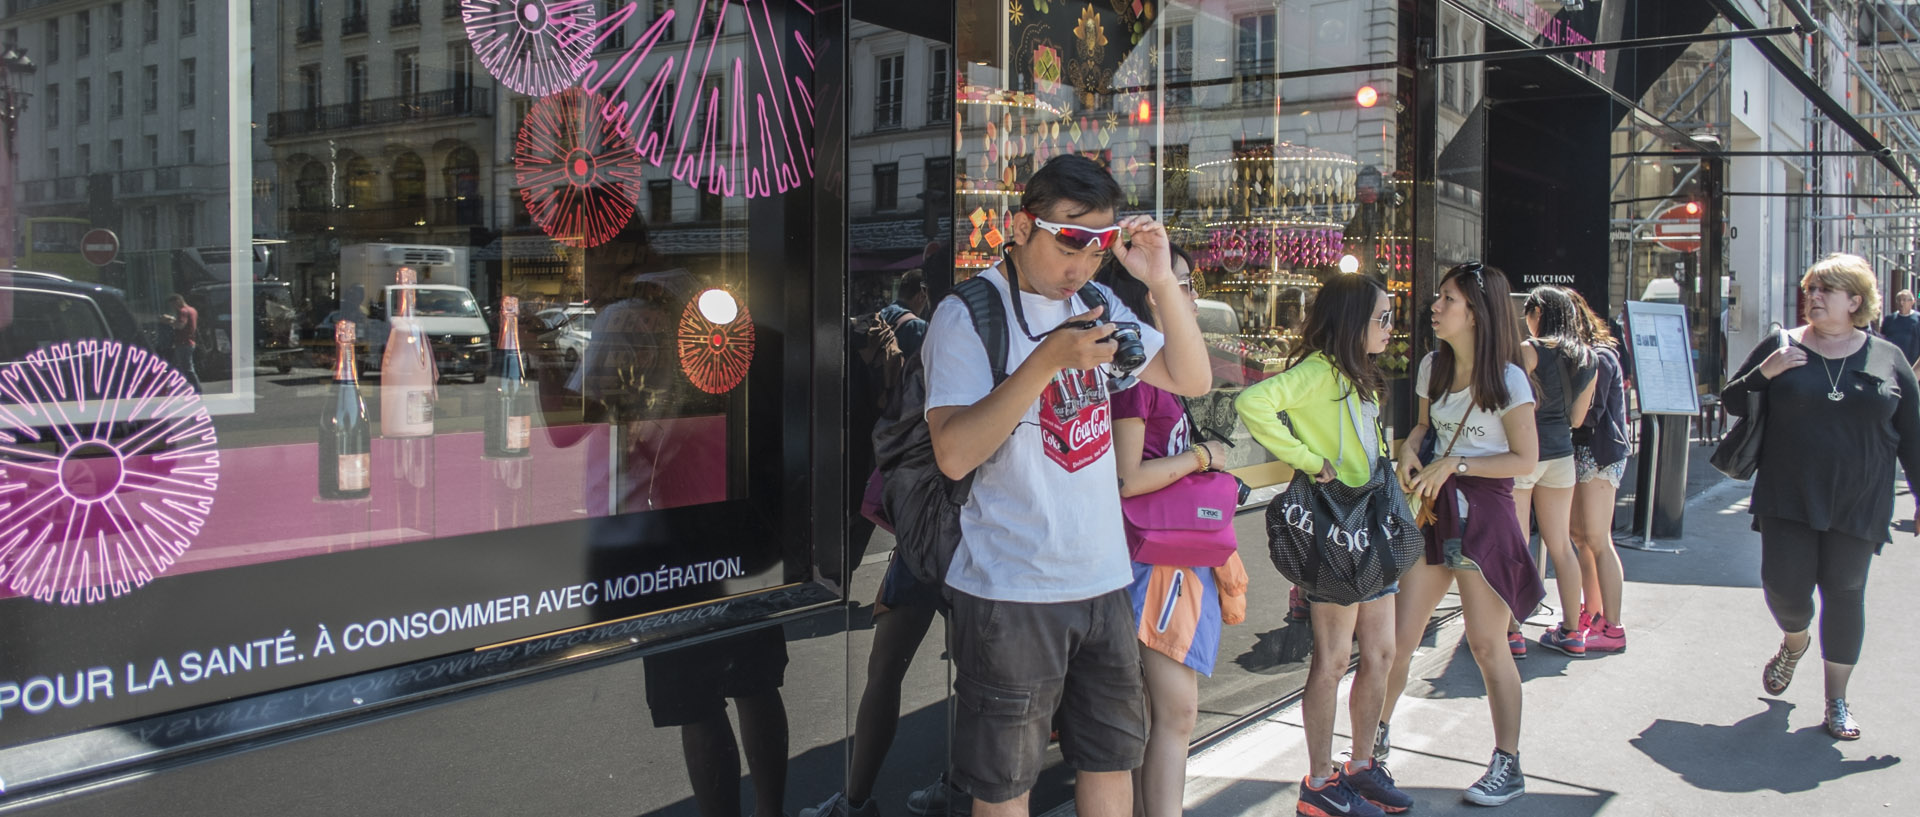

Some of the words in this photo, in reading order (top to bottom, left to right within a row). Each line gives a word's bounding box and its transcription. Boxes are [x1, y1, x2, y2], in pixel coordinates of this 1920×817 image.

[1523, 274, 1575, 283] FAUCHON
[0, 667, 114, 719] POUR
[126, 656, 174, 694] LA
[180, 629, 305, 683] SANTÉ.
[313, 623, 335, 658] À
[343, 594, 530, 651] CONSOMMER
[535, 582, 599, 616] AVEC
[604, 556, 746, 602] MODÉRATION.
